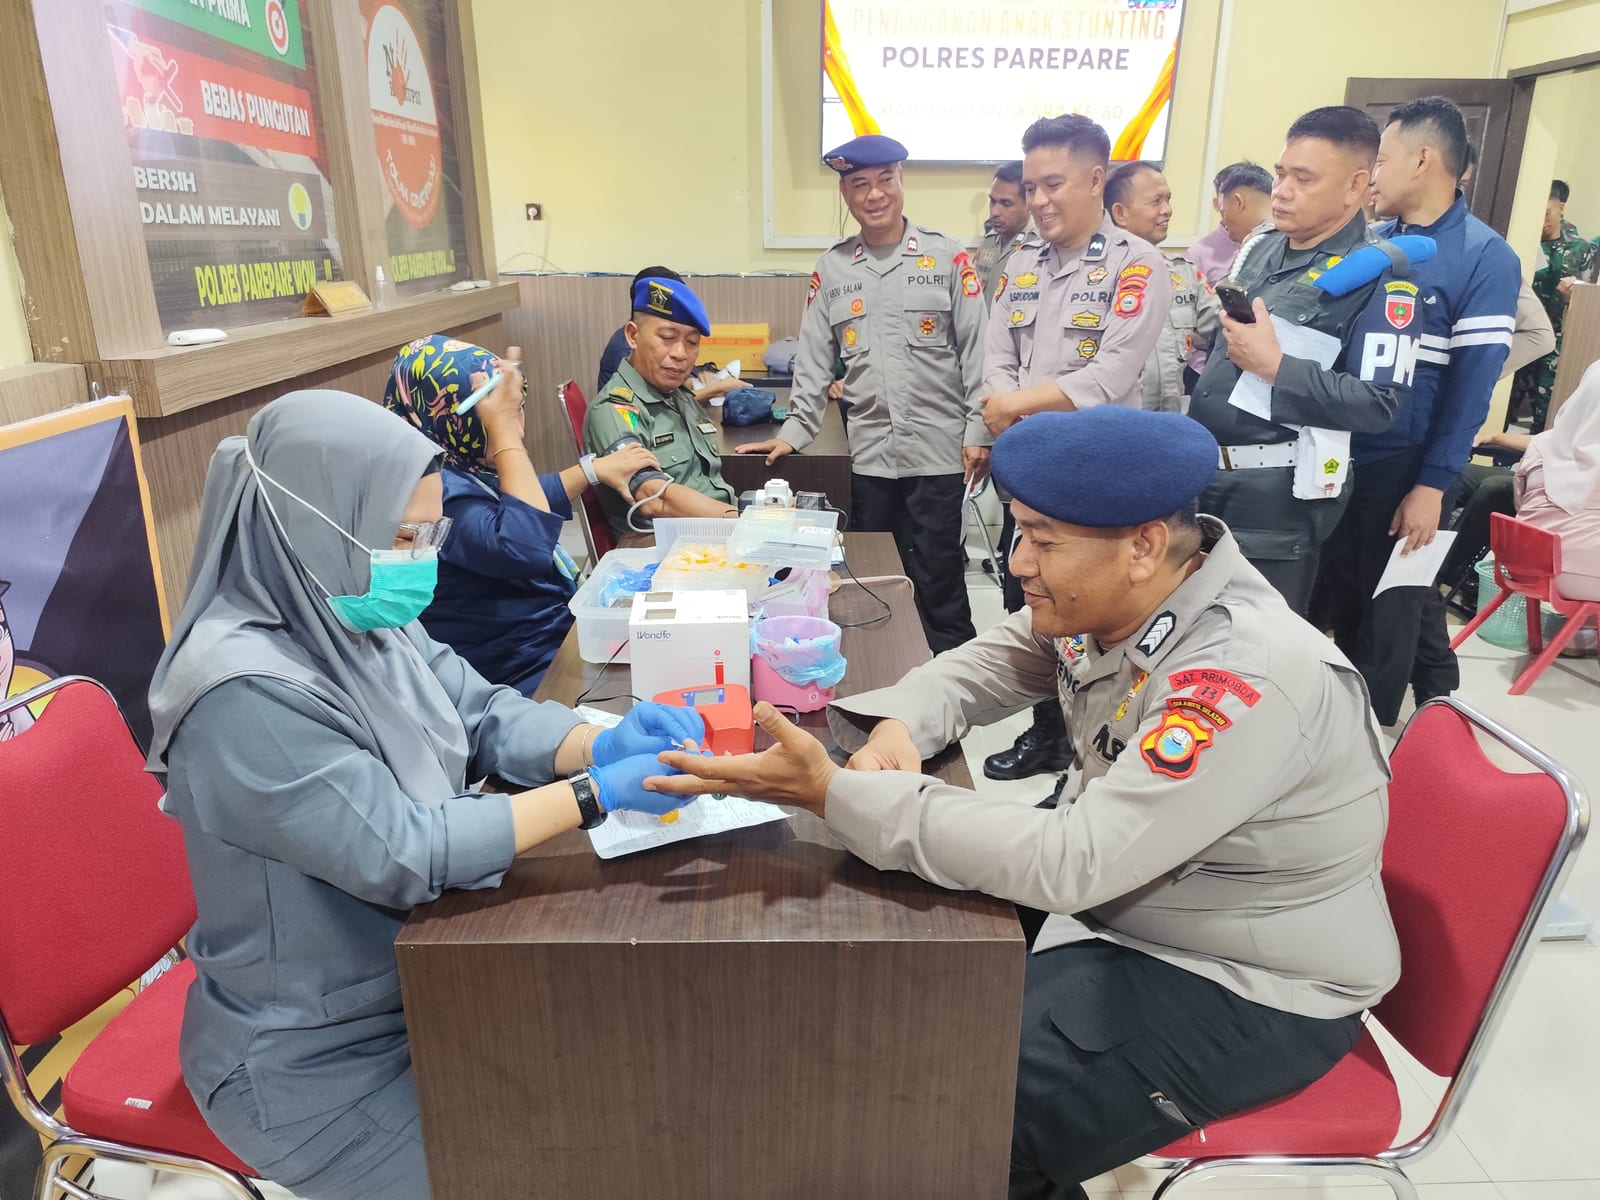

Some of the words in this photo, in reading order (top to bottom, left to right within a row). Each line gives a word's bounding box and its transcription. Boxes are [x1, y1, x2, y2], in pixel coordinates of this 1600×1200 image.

[1062, 9, 1166, 40] STUNTING
[882, 46, 985, 69] POLRES
[993, 47, 1130, 70] PAREPARE
[200, 79, 246, 123] BEBAS
[245, 92, 311, 137] PUNGUTAN
[133, 166, 197, 192] BERSIH
[139, 202, 206, 225] DALAM
[208, 206, 281, 226] MELAYANI
[194, 264, 242, 307] POLRES
[239, 261, 296, 301] PAREPARE
[843, 282, 863, 296] SALAM
[908, 274, 945, 285] POLRI
[1070, 291, 1114, 303] POLRI
[1360, 332, 1420, 387] PM
[636, 630, 671, 640] Wondfo
[1174, 673, 1195, 686] SAT
[1201, 672, 1254, 700] BRIMOBDA
